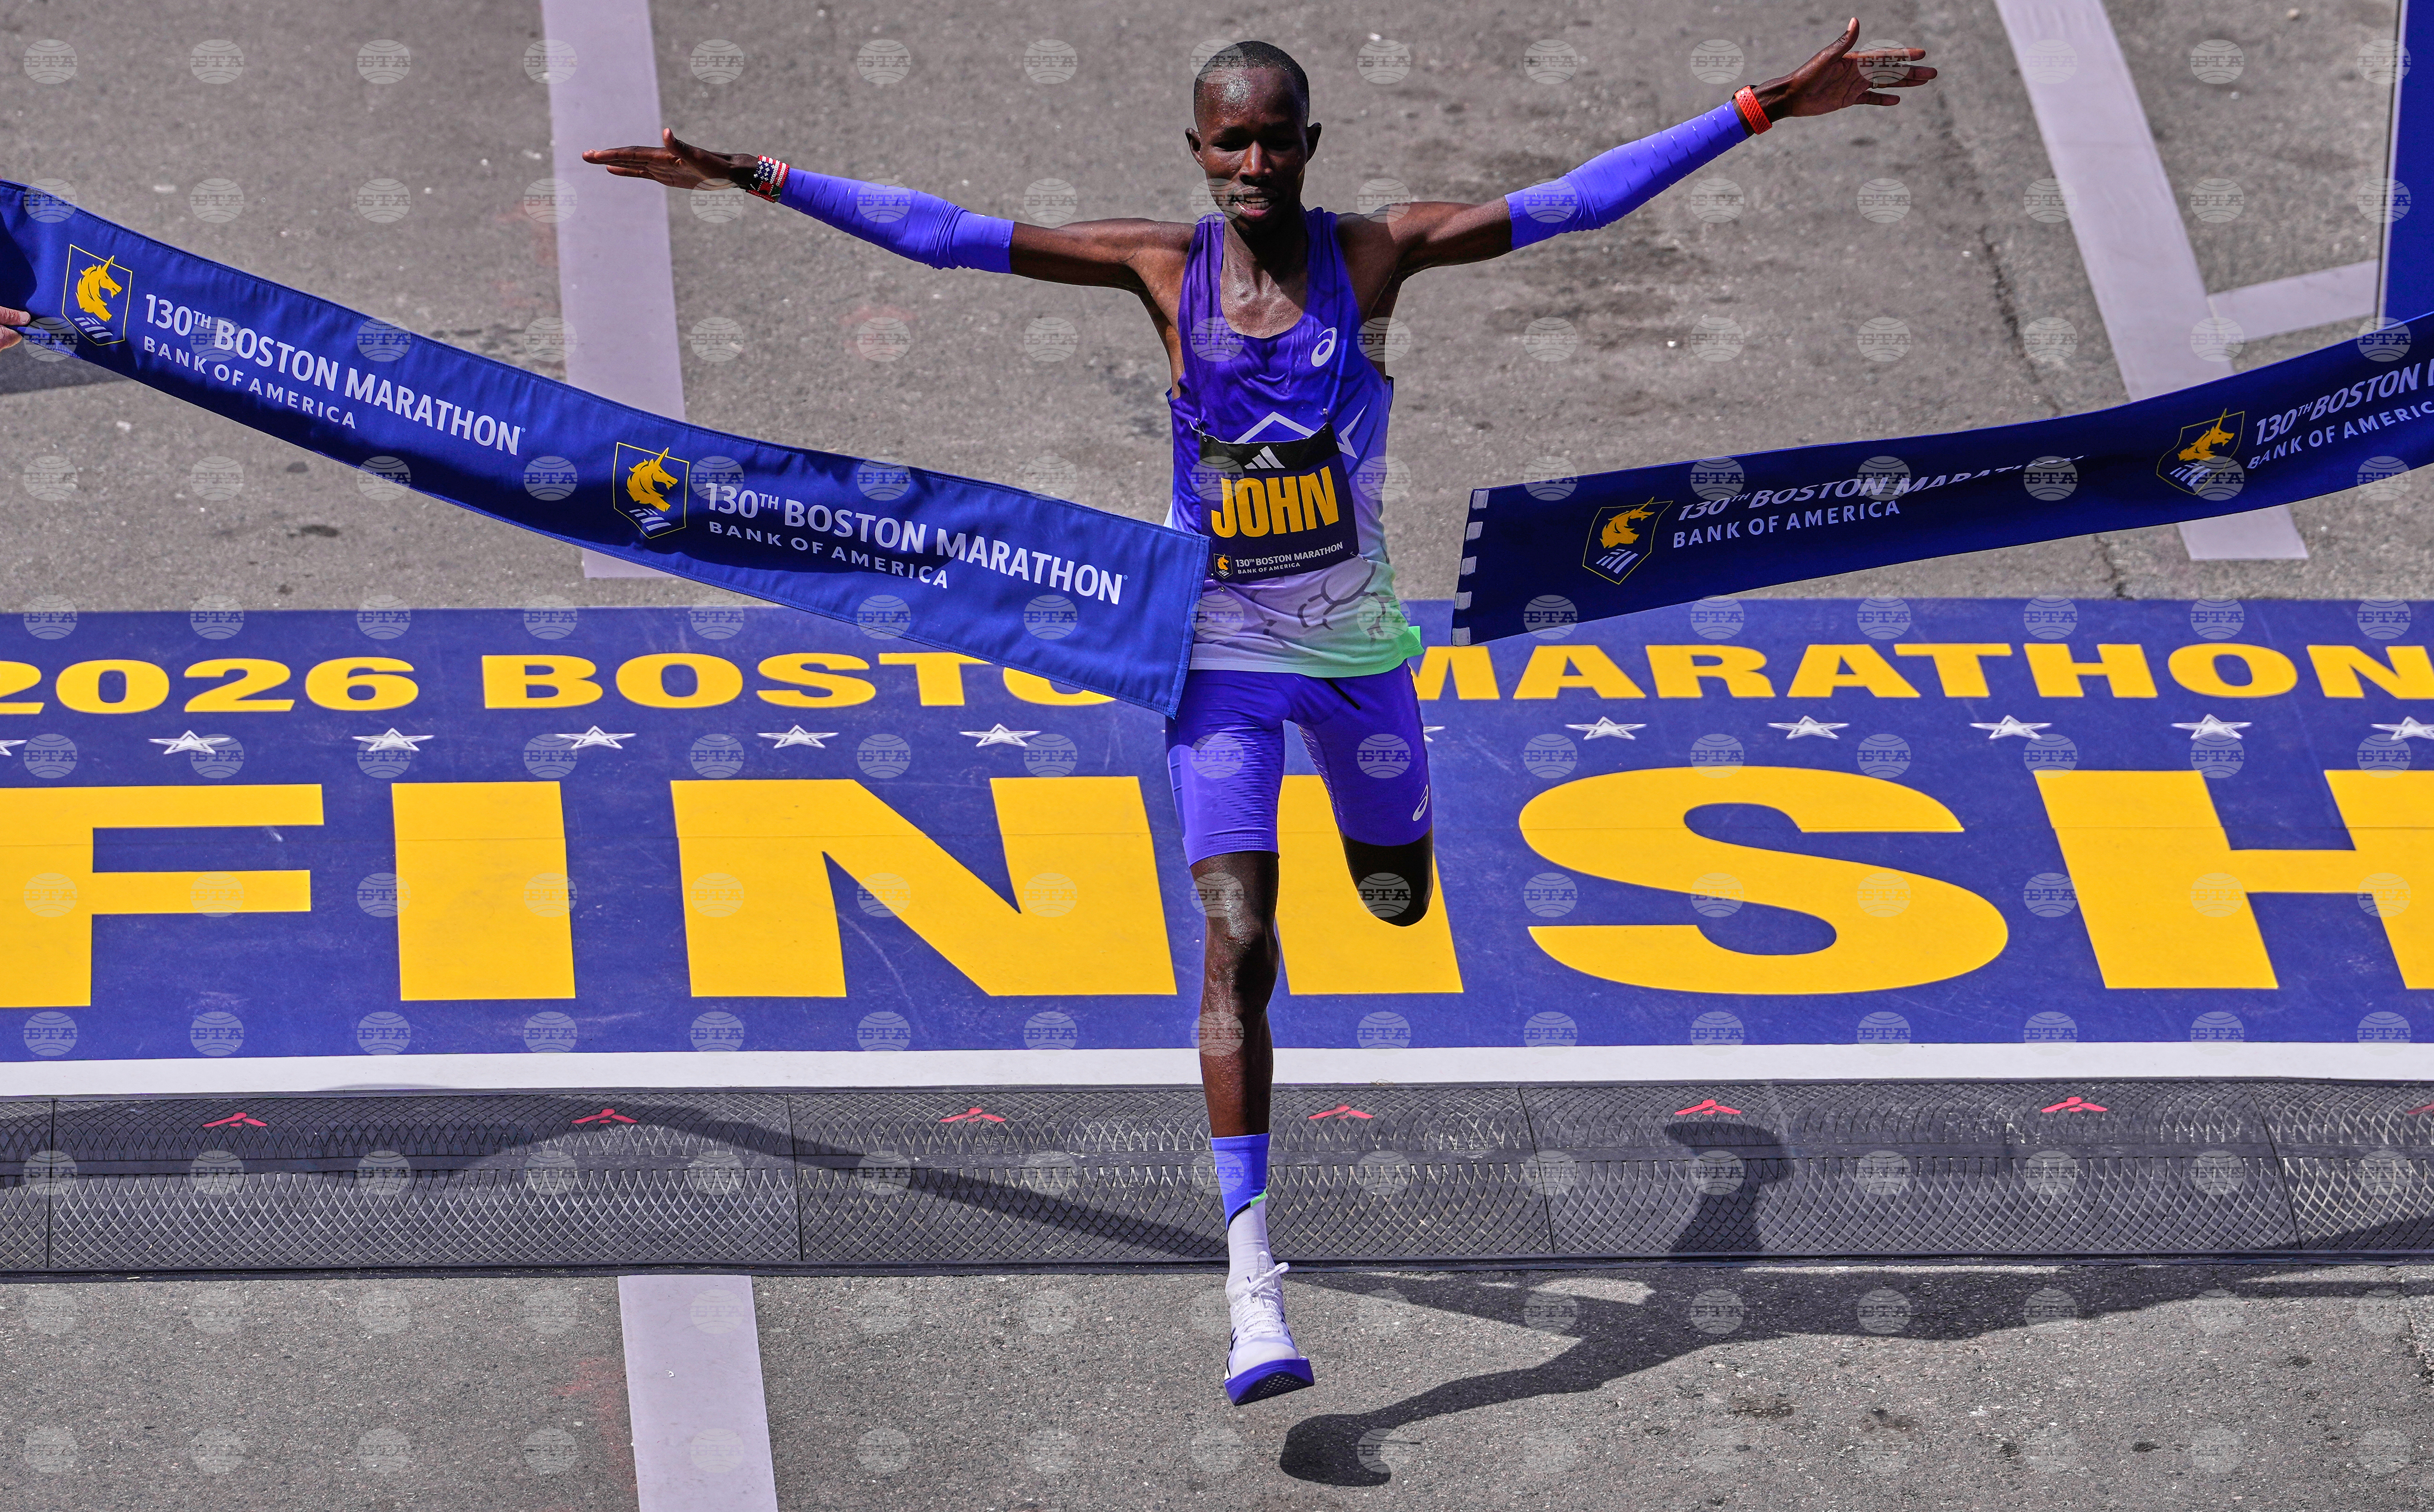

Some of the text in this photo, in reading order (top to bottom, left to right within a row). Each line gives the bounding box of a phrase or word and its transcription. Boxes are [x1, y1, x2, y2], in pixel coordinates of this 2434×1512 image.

[144, 336, 356, 429] BANK OF AMERICA
[213, 319, 339, 392] BOSTON
[2309, 362, 2421, 421] BOSTON
[2246, 400, 2434, 469] BANK OF AMERIC
[1211, 466, 1339, 538] JOHN
[1748, 476, 1890, 509] BOSTON
[784, 499, 927, 554] BOSTON
[1255, 554, 1292, 566] BOSTON
[1294, 541, 1343, 561] MARATHON
[1673, 500, 1901, 549] BANK OF AMERICA
[709, 520, 948, 589] BANK OF AMERICA
[1269, 562, 1301, 571] AMERICA
